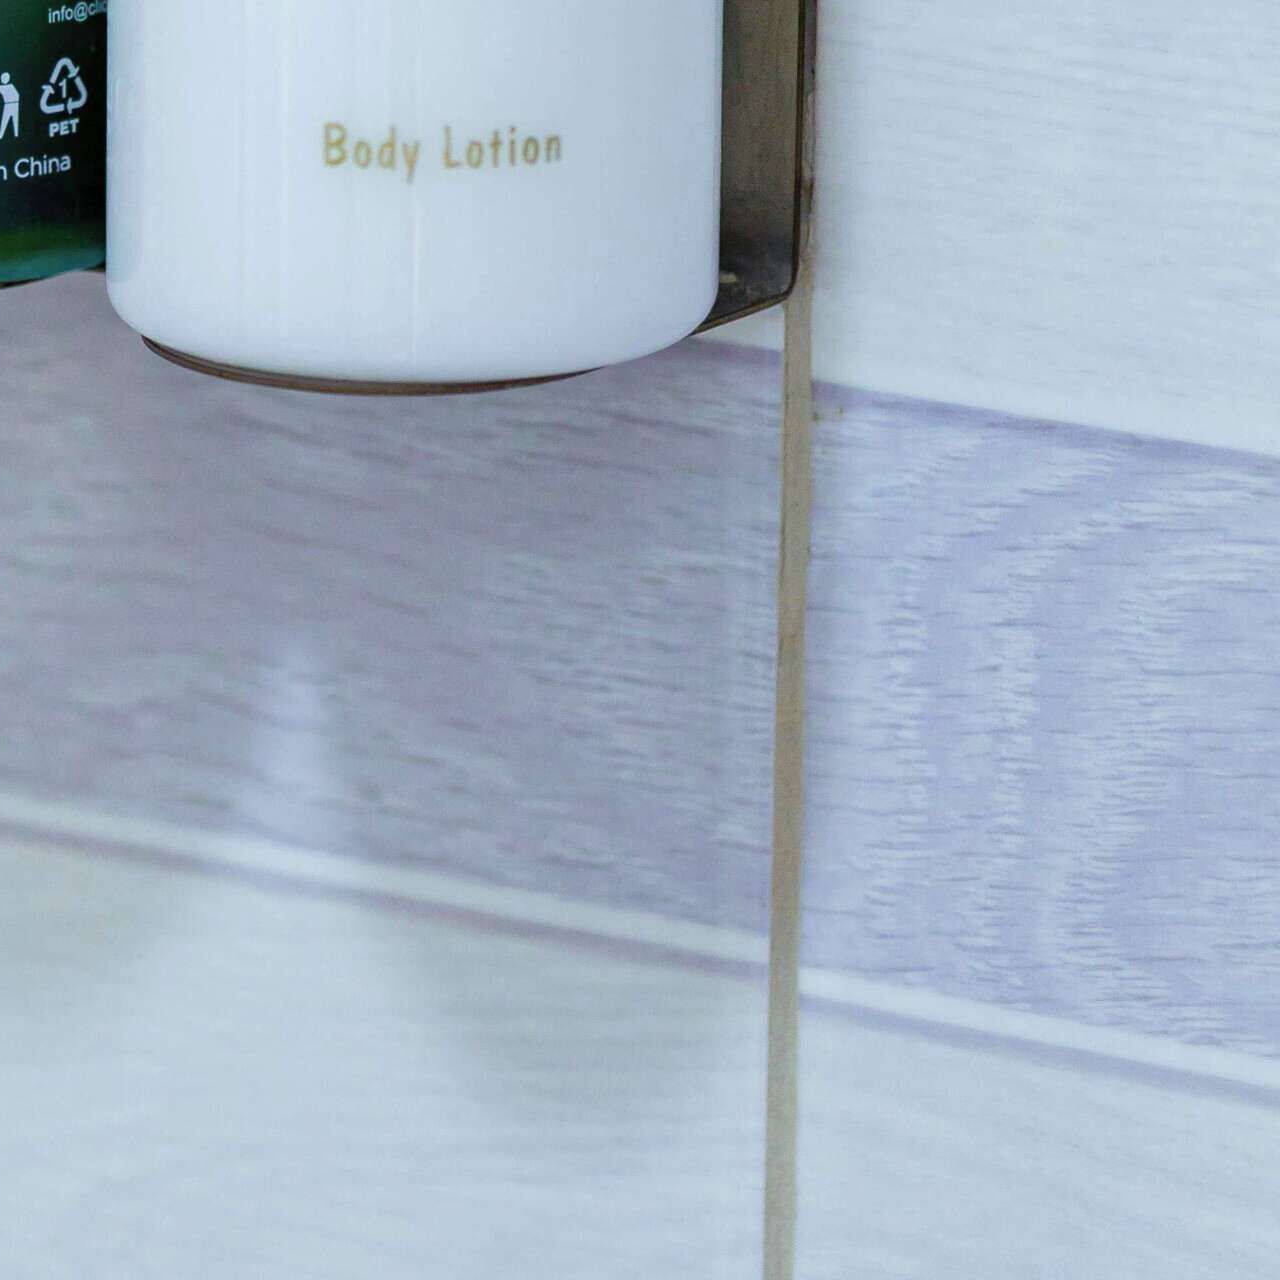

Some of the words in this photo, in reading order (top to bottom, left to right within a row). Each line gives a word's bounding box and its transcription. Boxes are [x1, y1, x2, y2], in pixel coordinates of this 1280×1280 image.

[48, 118, 80, 138] PET
[323, 122, 420, 184] Body
[442, 125, 561, 169] Lotion
[14, 154, 71, 178] China
